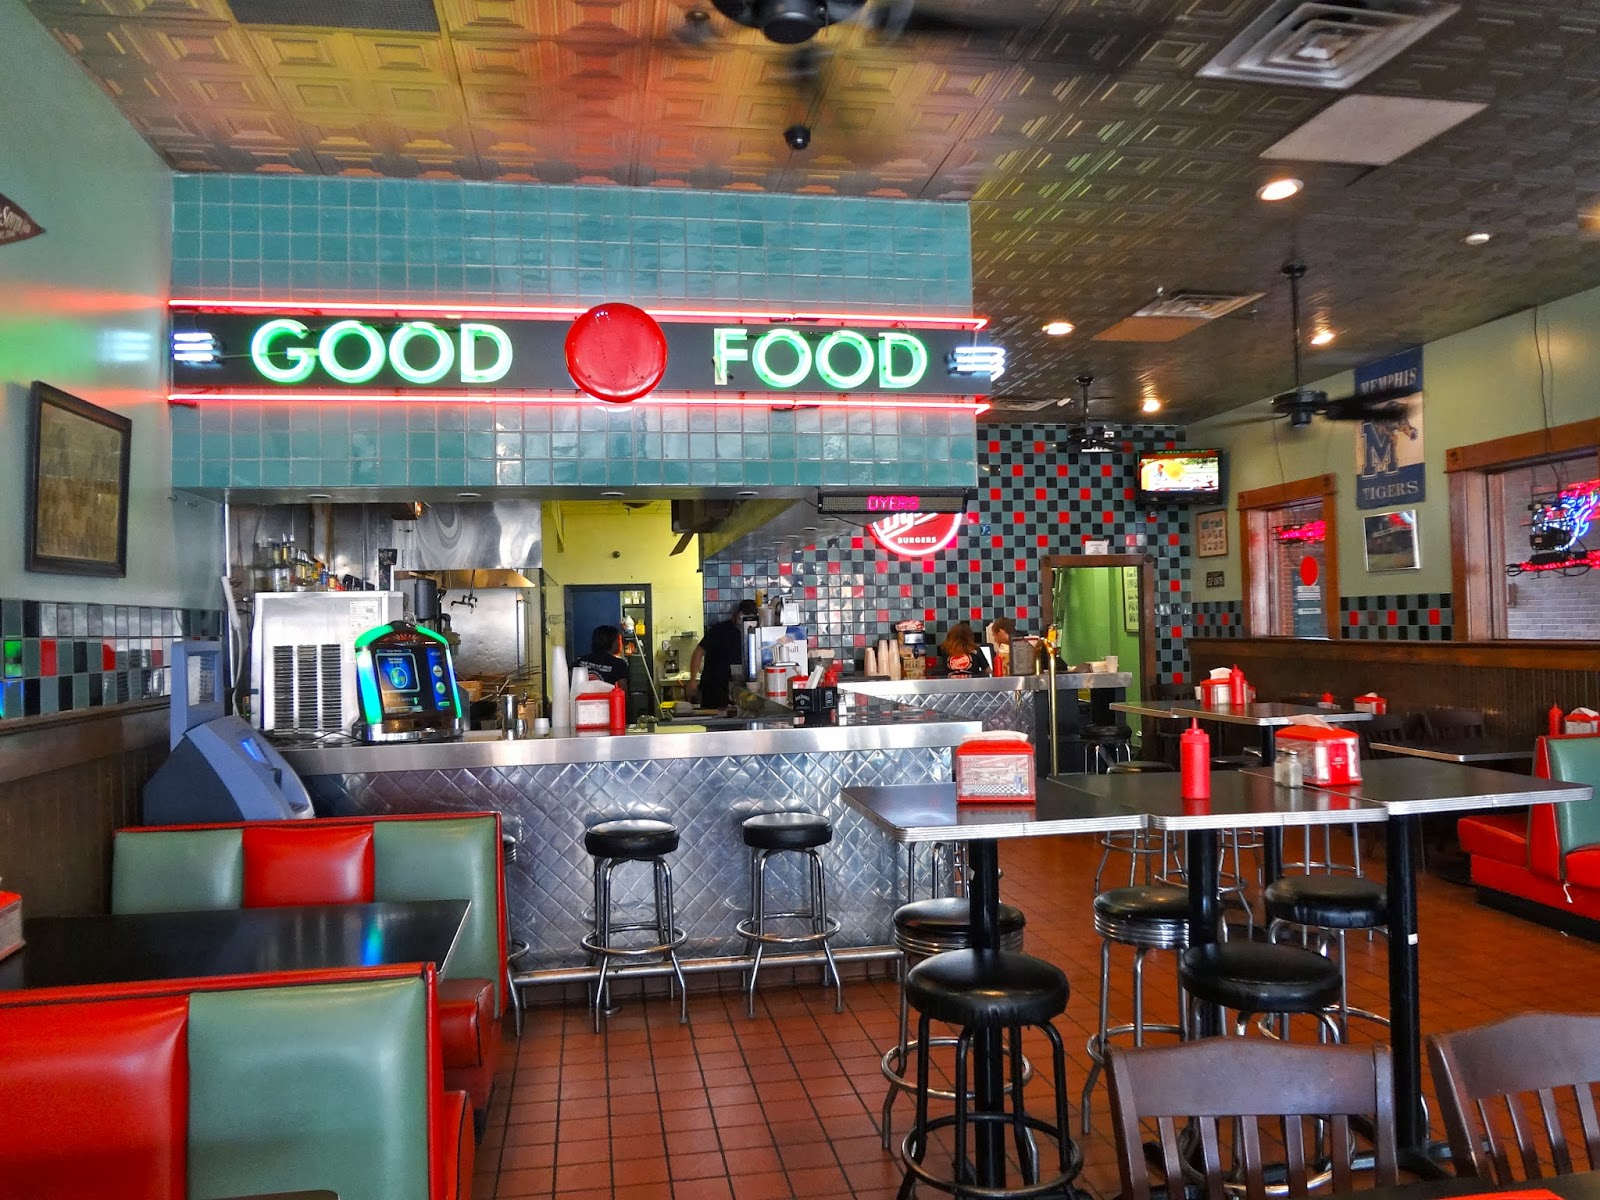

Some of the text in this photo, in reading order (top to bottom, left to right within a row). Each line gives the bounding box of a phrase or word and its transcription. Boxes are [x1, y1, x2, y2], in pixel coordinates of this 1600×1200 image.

[251, 318, 928, 388] GOOD FOOD
[1360, 367, 1417, 394] MEMPHIS
[1362, 481, 1419, 500] TIGERS
[897, 536, 937, 544] BURGERS
